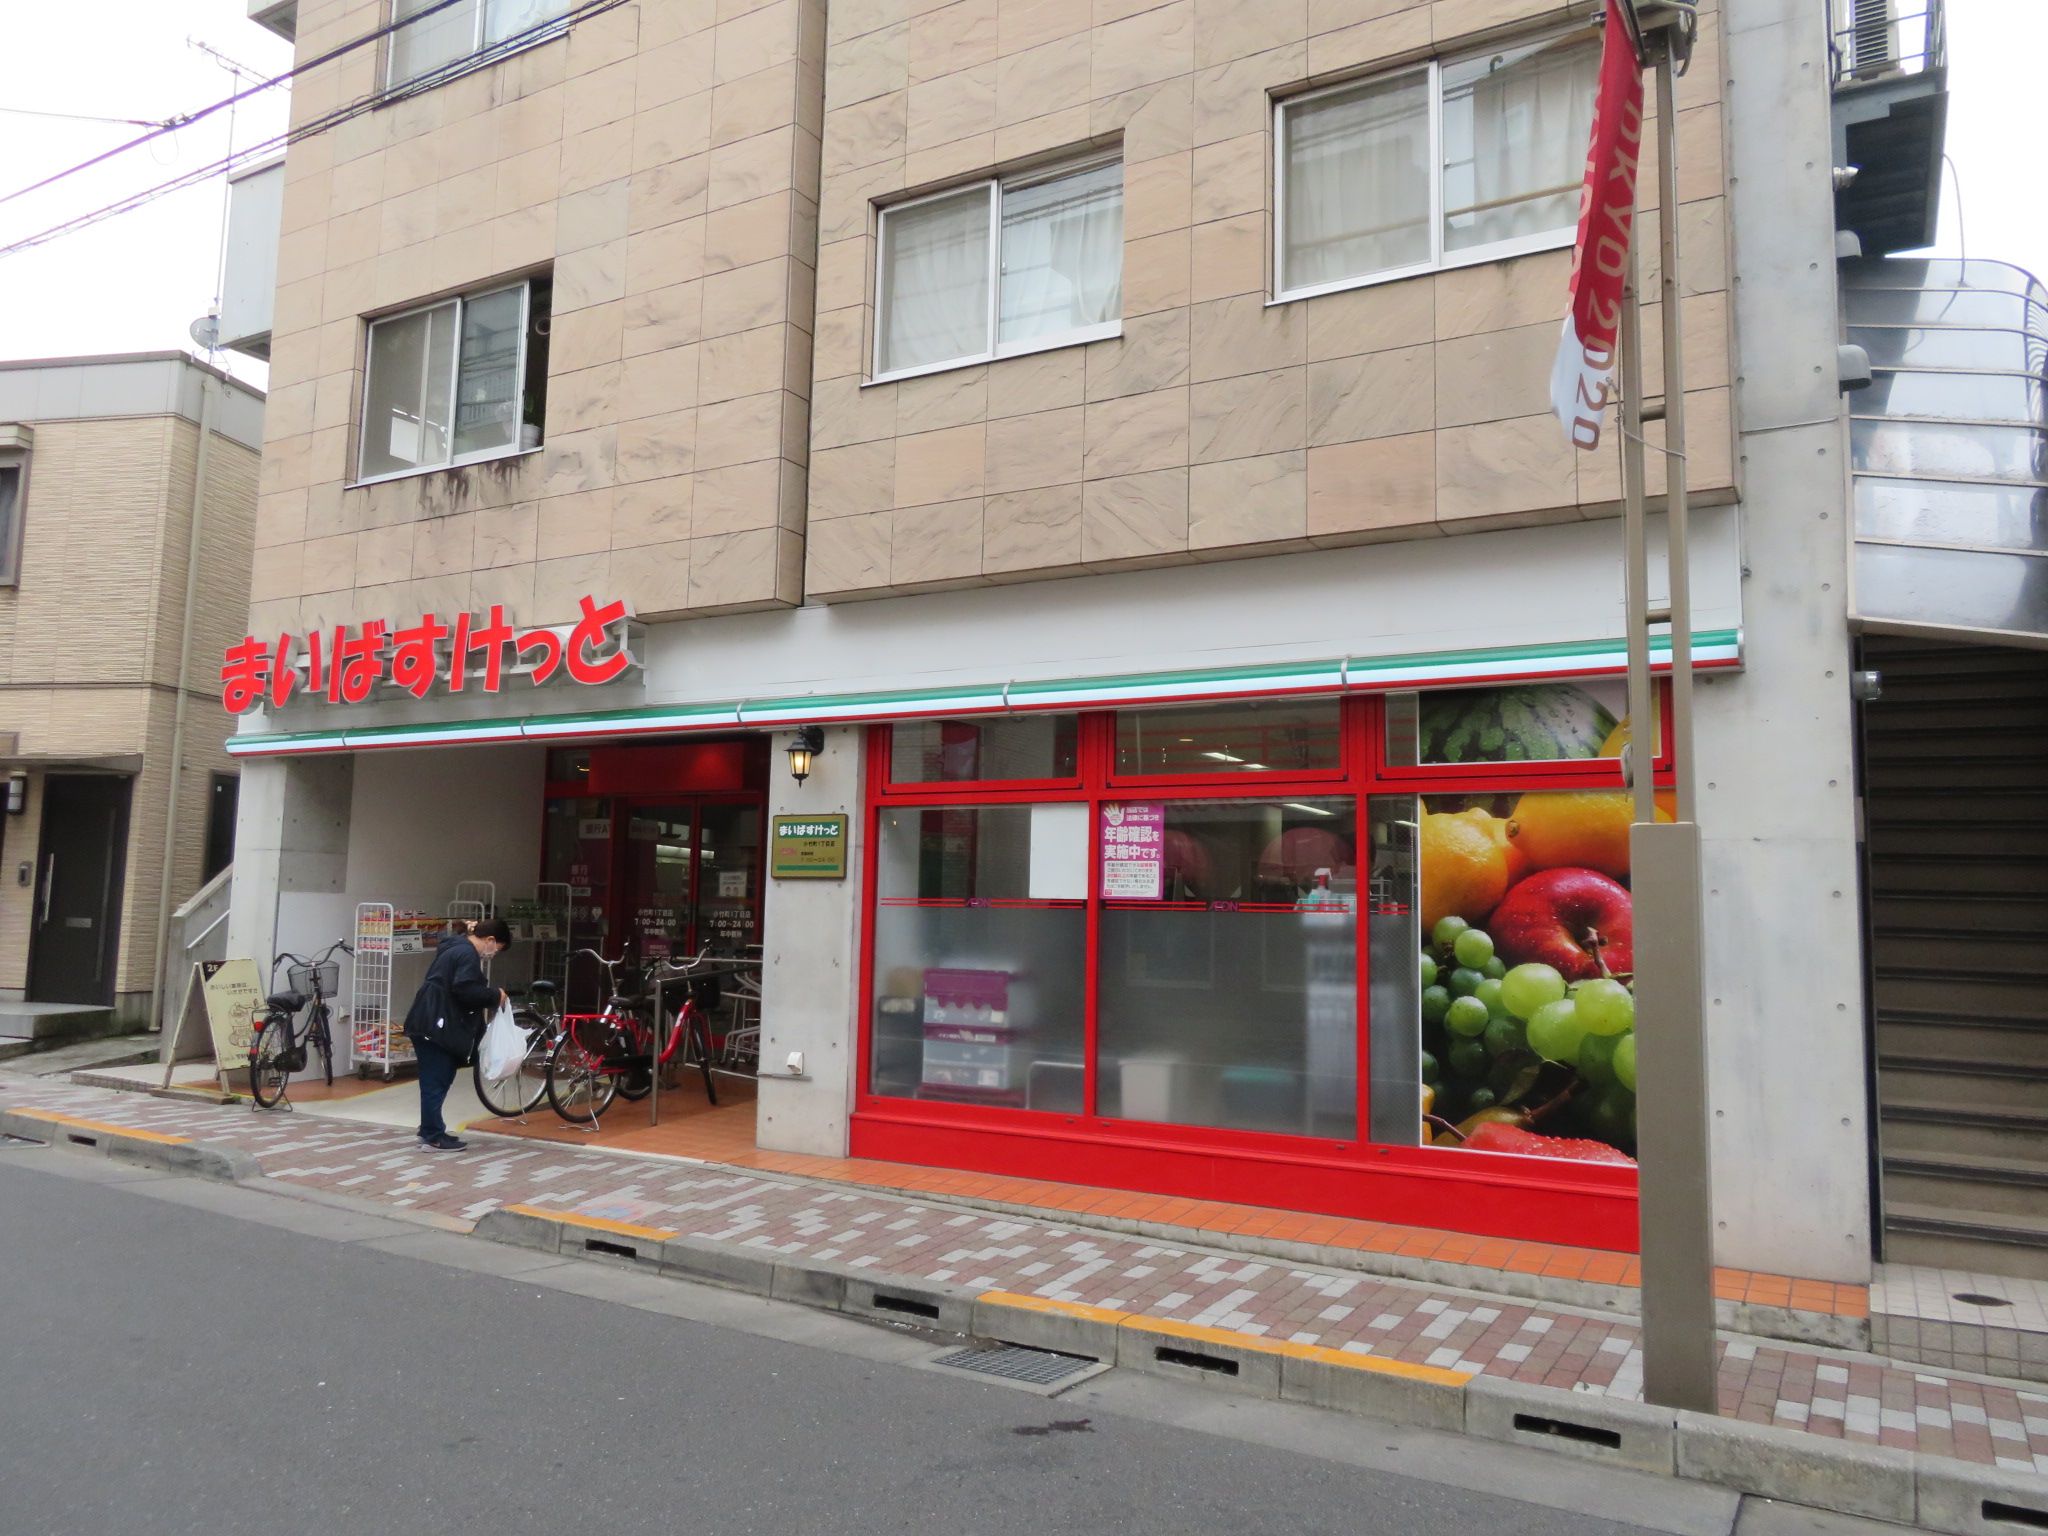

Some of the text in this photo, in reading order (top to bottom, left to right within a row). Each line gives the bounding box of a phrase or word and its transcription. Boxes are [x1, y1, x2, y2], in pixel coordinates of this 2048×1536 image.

[1573, 287, 1620, 452] 2020
[220, 594, 632, 714] まいばすけっと
[586, 824, 611, 834] 銀行A
[778, 824, 839, 836] まいばすけっと
[1104, 826, 1160, 843] 年齢確認を
[1104, 844, 1160, 859] 実施中です。
[207, 964, 219, 972] 2F
